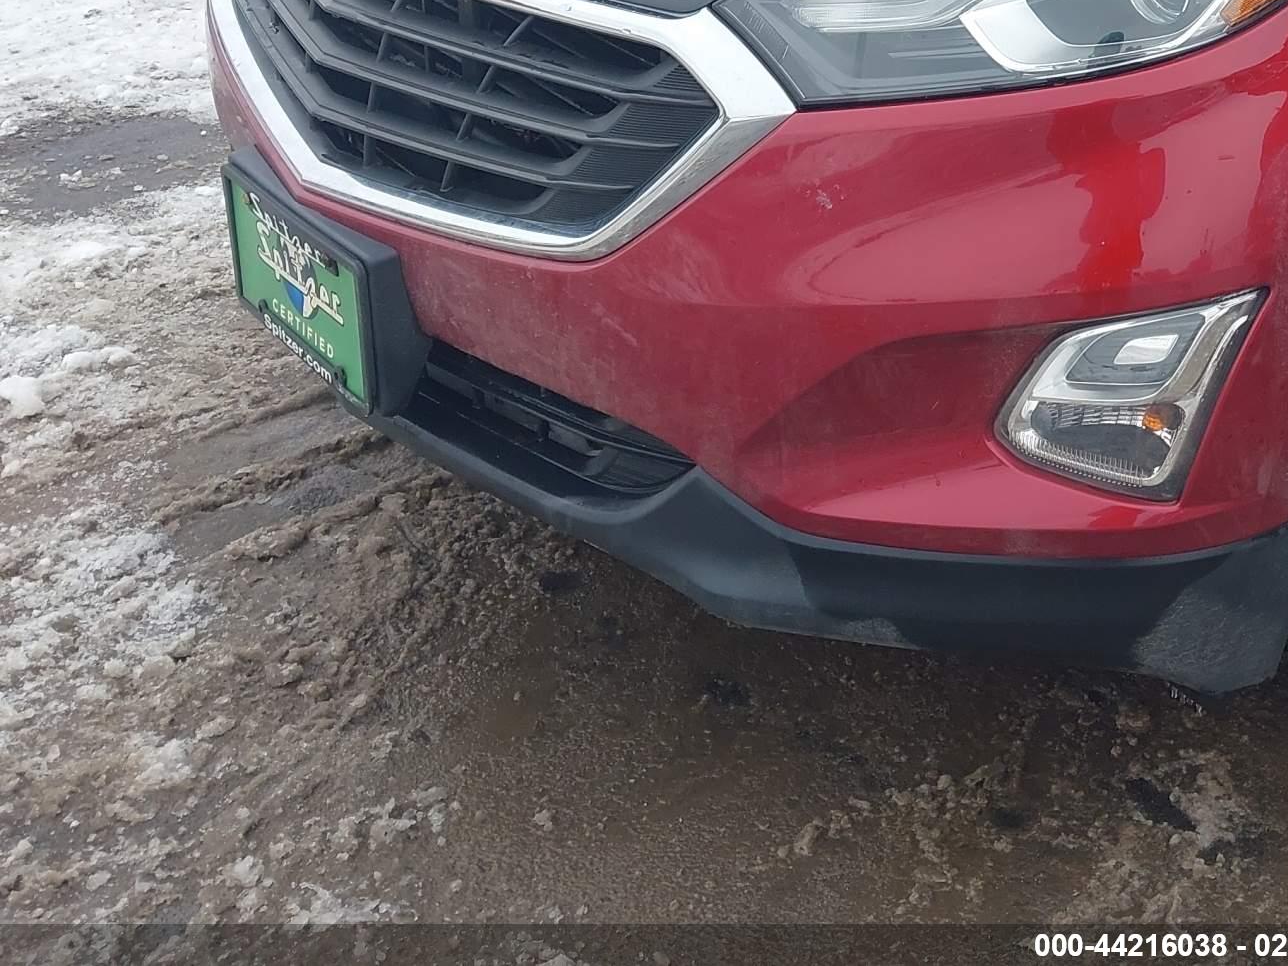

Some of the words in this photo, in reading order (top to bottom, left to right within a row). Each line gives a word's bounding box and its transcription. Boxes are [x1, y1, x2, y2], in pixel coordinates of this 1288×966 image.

[249, 192, 326, 268] Spitzer
[256, 221, 345, 326] Spitzer
[263, 313, 333, 384] Spitzer.com
[272, 297, 335, 359] CERTIFIED
